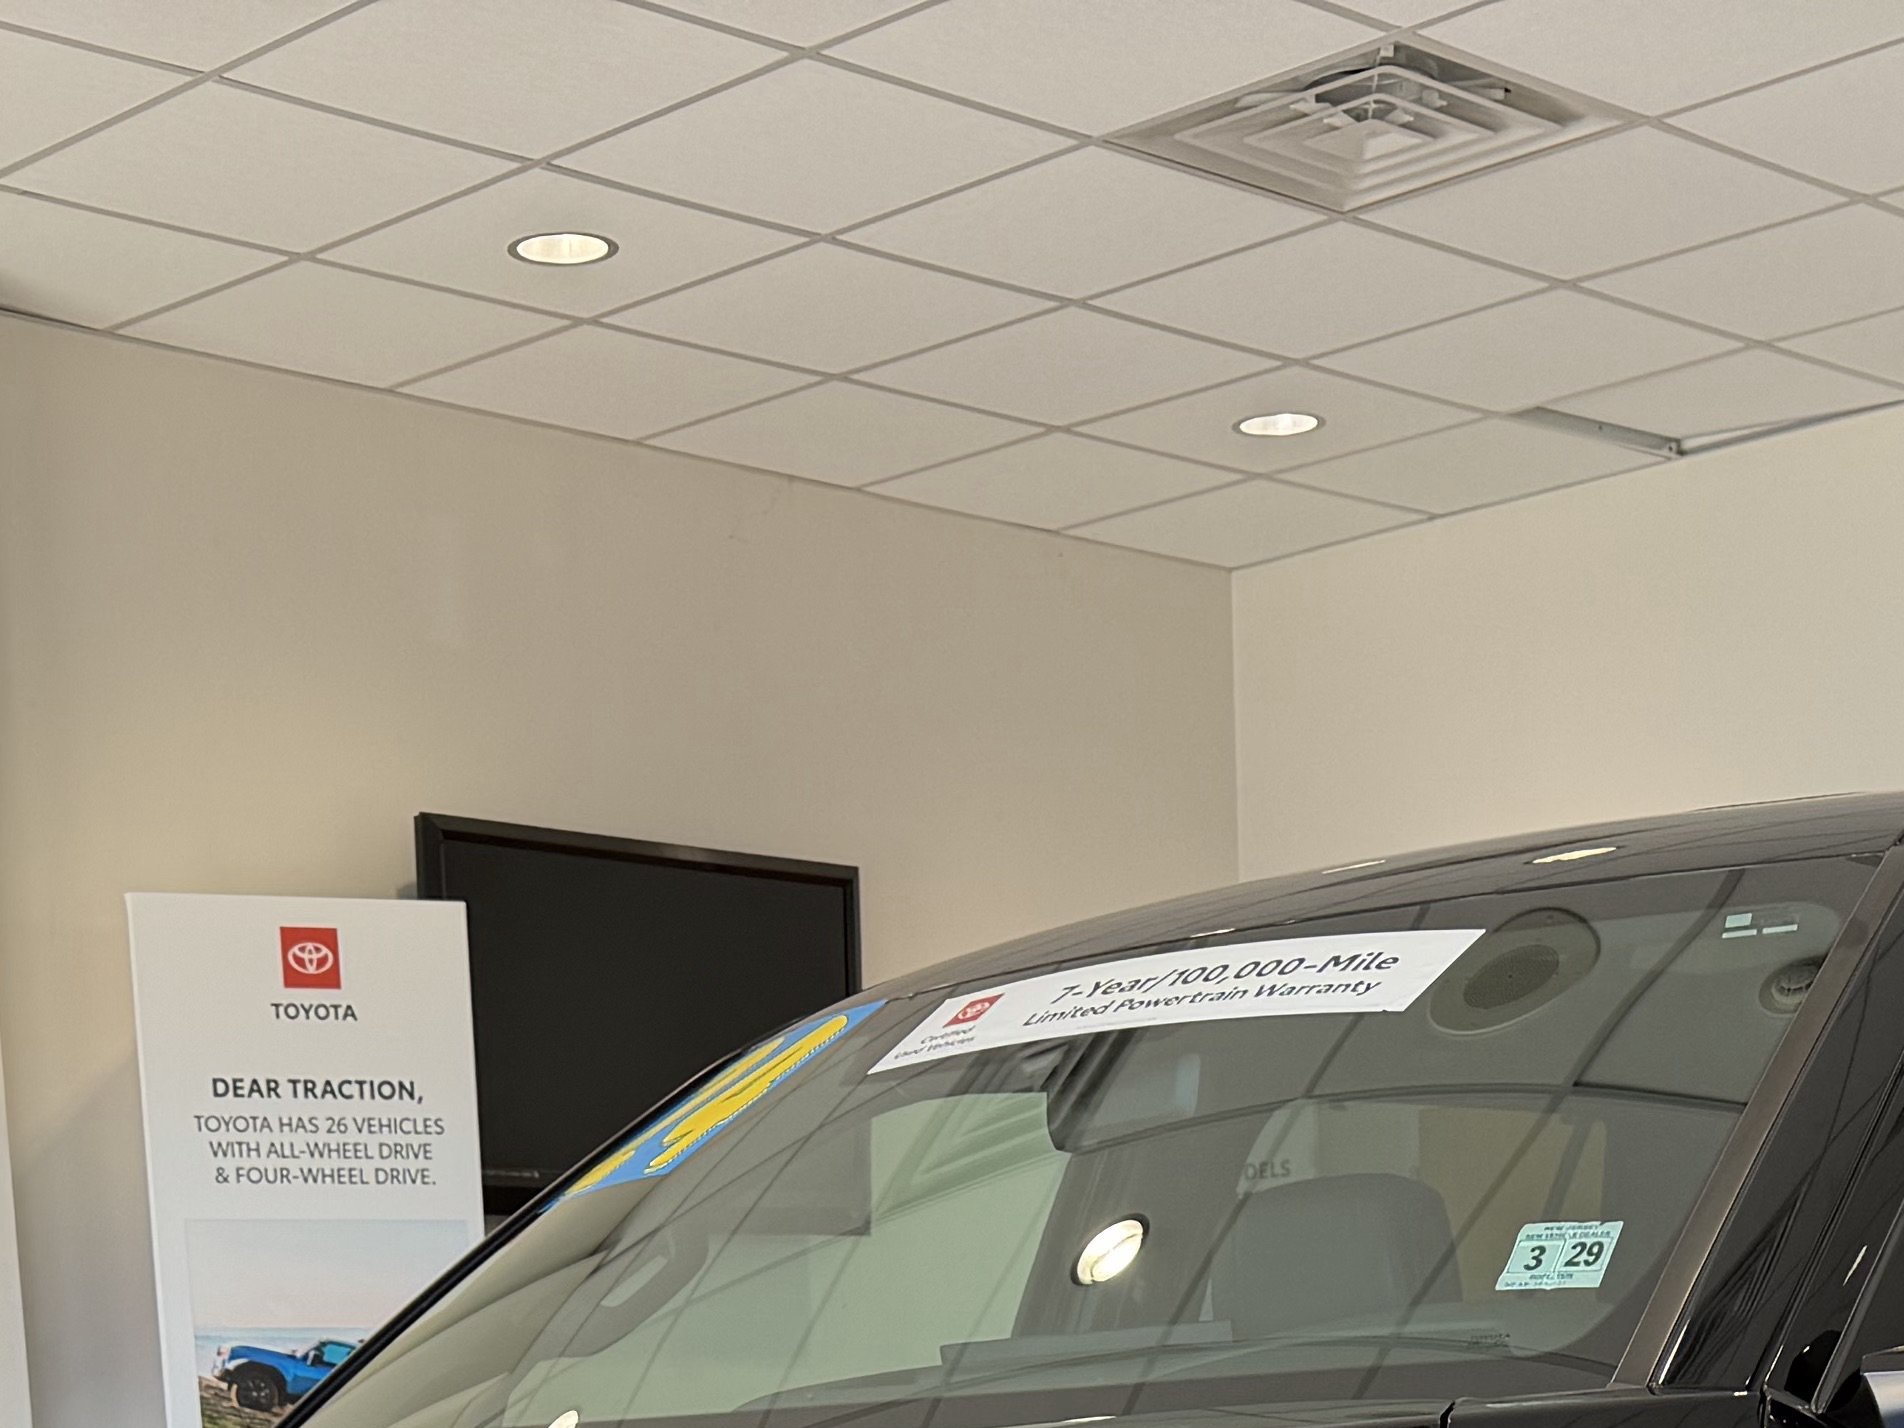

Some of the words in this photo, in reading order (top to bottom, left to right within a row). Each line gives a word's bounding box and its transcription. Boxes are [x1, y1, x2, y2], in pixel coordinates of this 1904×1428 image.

[1050, 951, 1400, 1004] 7-Year/100,000-Mile
[271, 1003, 358, 1021] TOYOTA
[1022, 1000, 1108, 1027] Limited
[1112, 983, 1249, 1014] Powertrain
[1253, 979, 1384, 999] Warranty
[211, 1078, 281, 1099] DEAR
[287, 1079, 424, 1104] TRACTION,
[193, 1115, 273, 1134] TOYOTA
[278, 1116, 320, 1134] HAS
[325, 1117, 348, 1134] 26
[352, 1117, 446, 1135] VEHICLES
[209, 1141, 260, 1159] WITH
[266, 1142, 374, 1160] ALL-WHEEL
[378, 1143, 433, 1161] DRIVE
[215, 1167, 230, 1184] &
[236, 1167, 370, 1185] FOUR-WHEEL
[374, 1168, 437, 1186] DRIVE.
[1523, 1245, 1546, 1271] 3
[1563, 1240, 1604, 1267] 29
